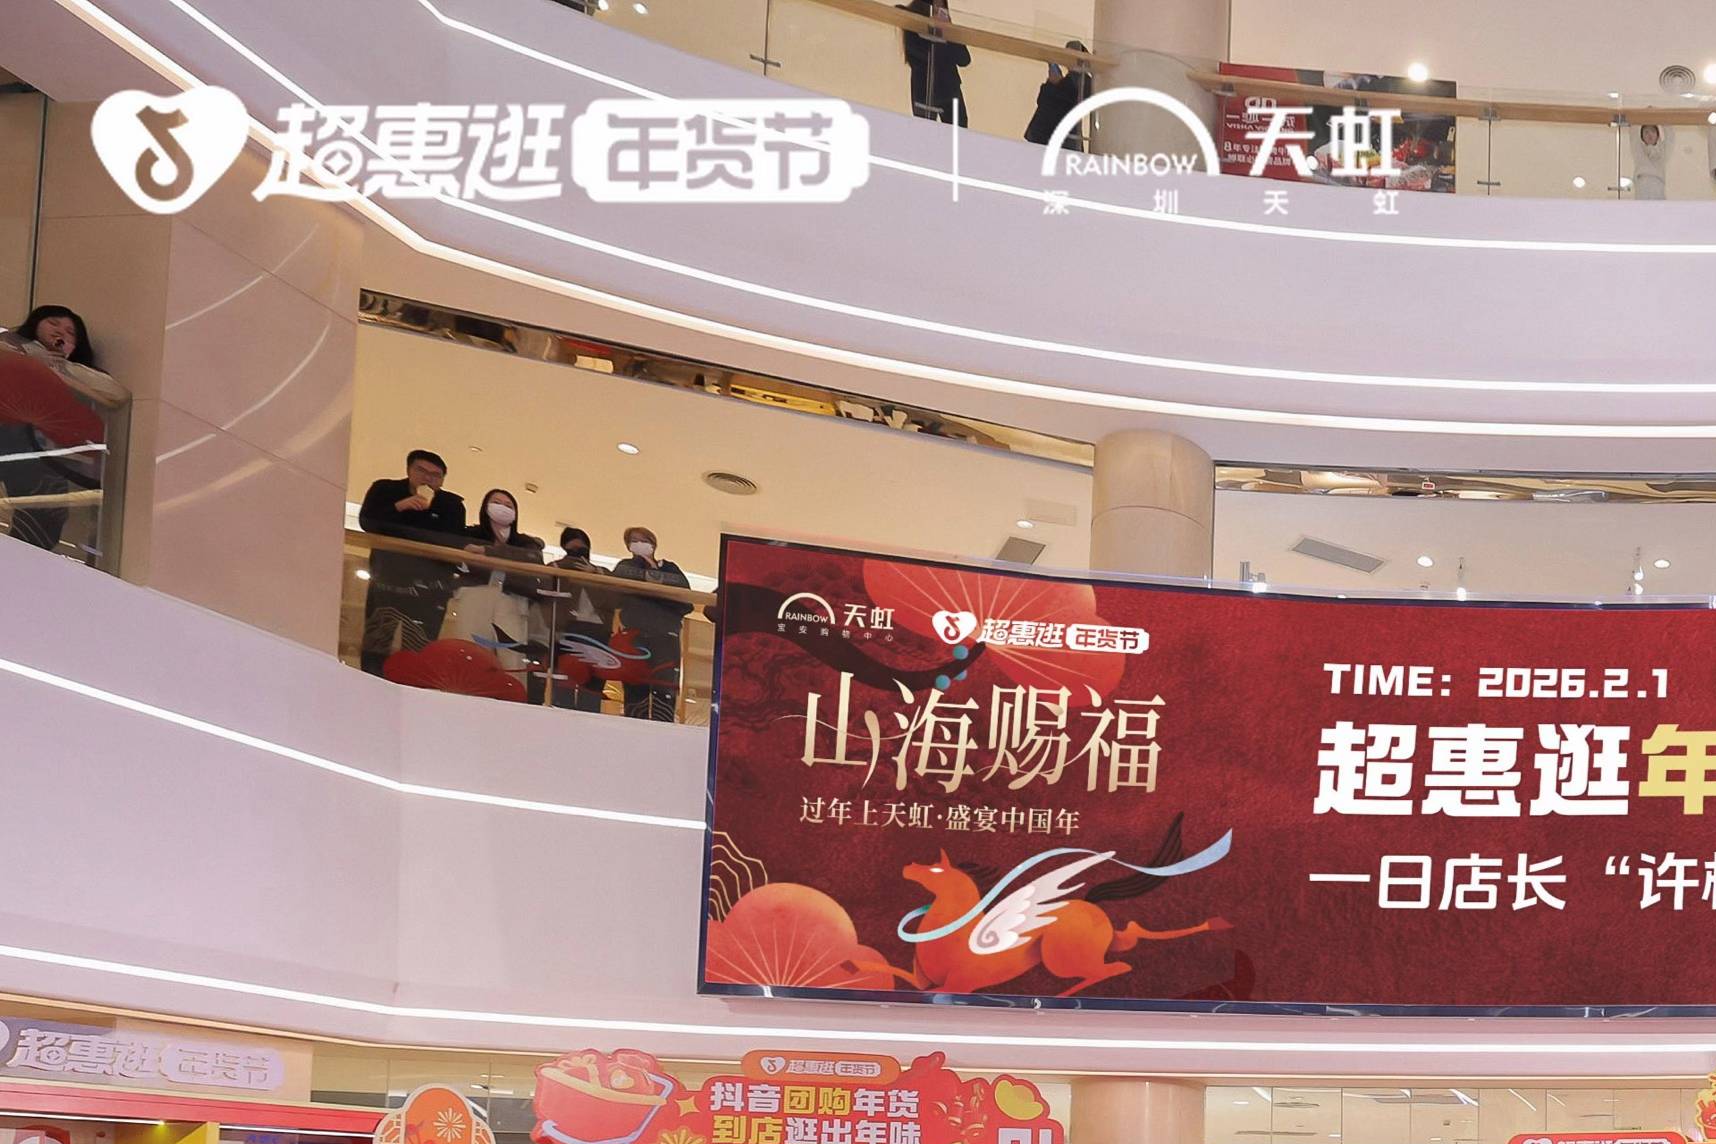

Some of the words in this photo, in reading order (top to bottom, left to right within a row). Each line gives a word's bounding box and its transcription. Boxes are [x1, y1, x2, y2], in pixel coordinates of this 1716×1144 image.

[777, 623, 895, 642] 宝安购物中心
[785, 610, 829, 625] RAINBOW
[843, 602, 896, 632] 天虹
[978, 617, 1064, 648] 超惠逛
[1478, 667, 1670, 699] 2026.2.1
[799, 671, 1166, 793] 山海赐福
[799, 796, 1081, 835] 过年上天虹·盛宴中国年
[1309, 854, 1567, 912] 一日店长
[708, 1080, 921, 1119] 抖音团购年货
